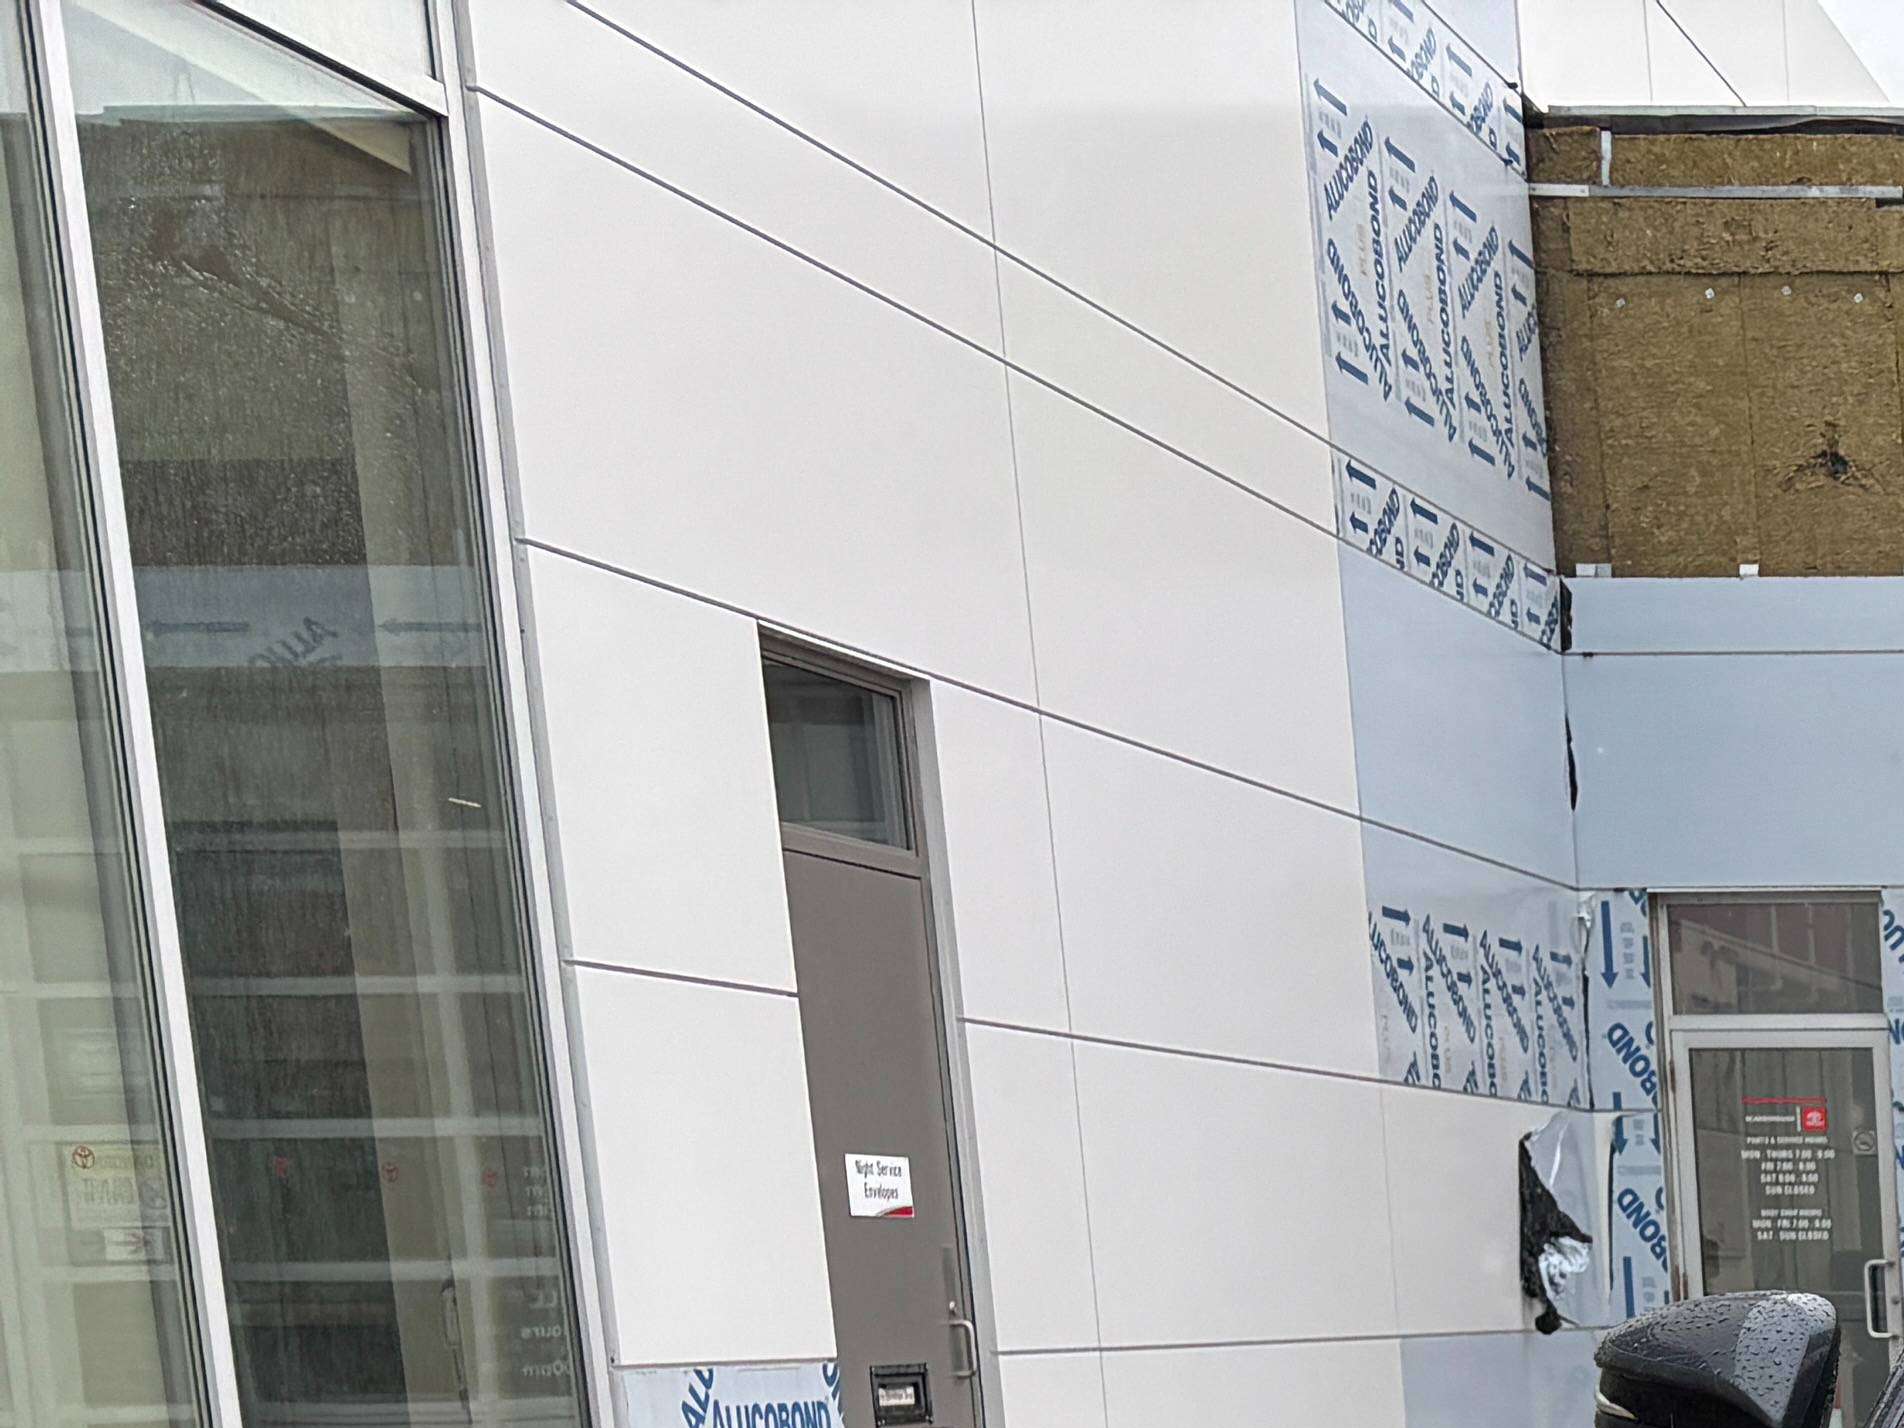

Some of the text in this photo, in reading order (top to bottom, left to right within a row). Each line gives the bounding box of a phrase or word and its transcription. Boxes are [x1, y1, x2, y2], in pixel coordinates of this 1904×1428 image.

[1324, 121, 1373, 221] ALUCOBOND
[1394, 175, 1439, 273] ALUCOBOND
[1327, 238, 1392, 401] ALUCOBOND
[1367, 169, 1391, 366] ALUCOBOND
[1434, 223, 1456, 410] ALUCOBOND
[1397, 289, 1457, 442] ALUCOBOND
[1460, 335, 1515, 480] ALUCOBOND
[1494, 271, 1515, 449] ALUCOBOND
[1423, 914, 1475, 1044] ALUCOBOND
[1480, 929, 1529, 1054] ALUCOBOND
[1607, 1022, 1658, 1107] BOND
[1616, 1187, 1668, 1273] BOND
